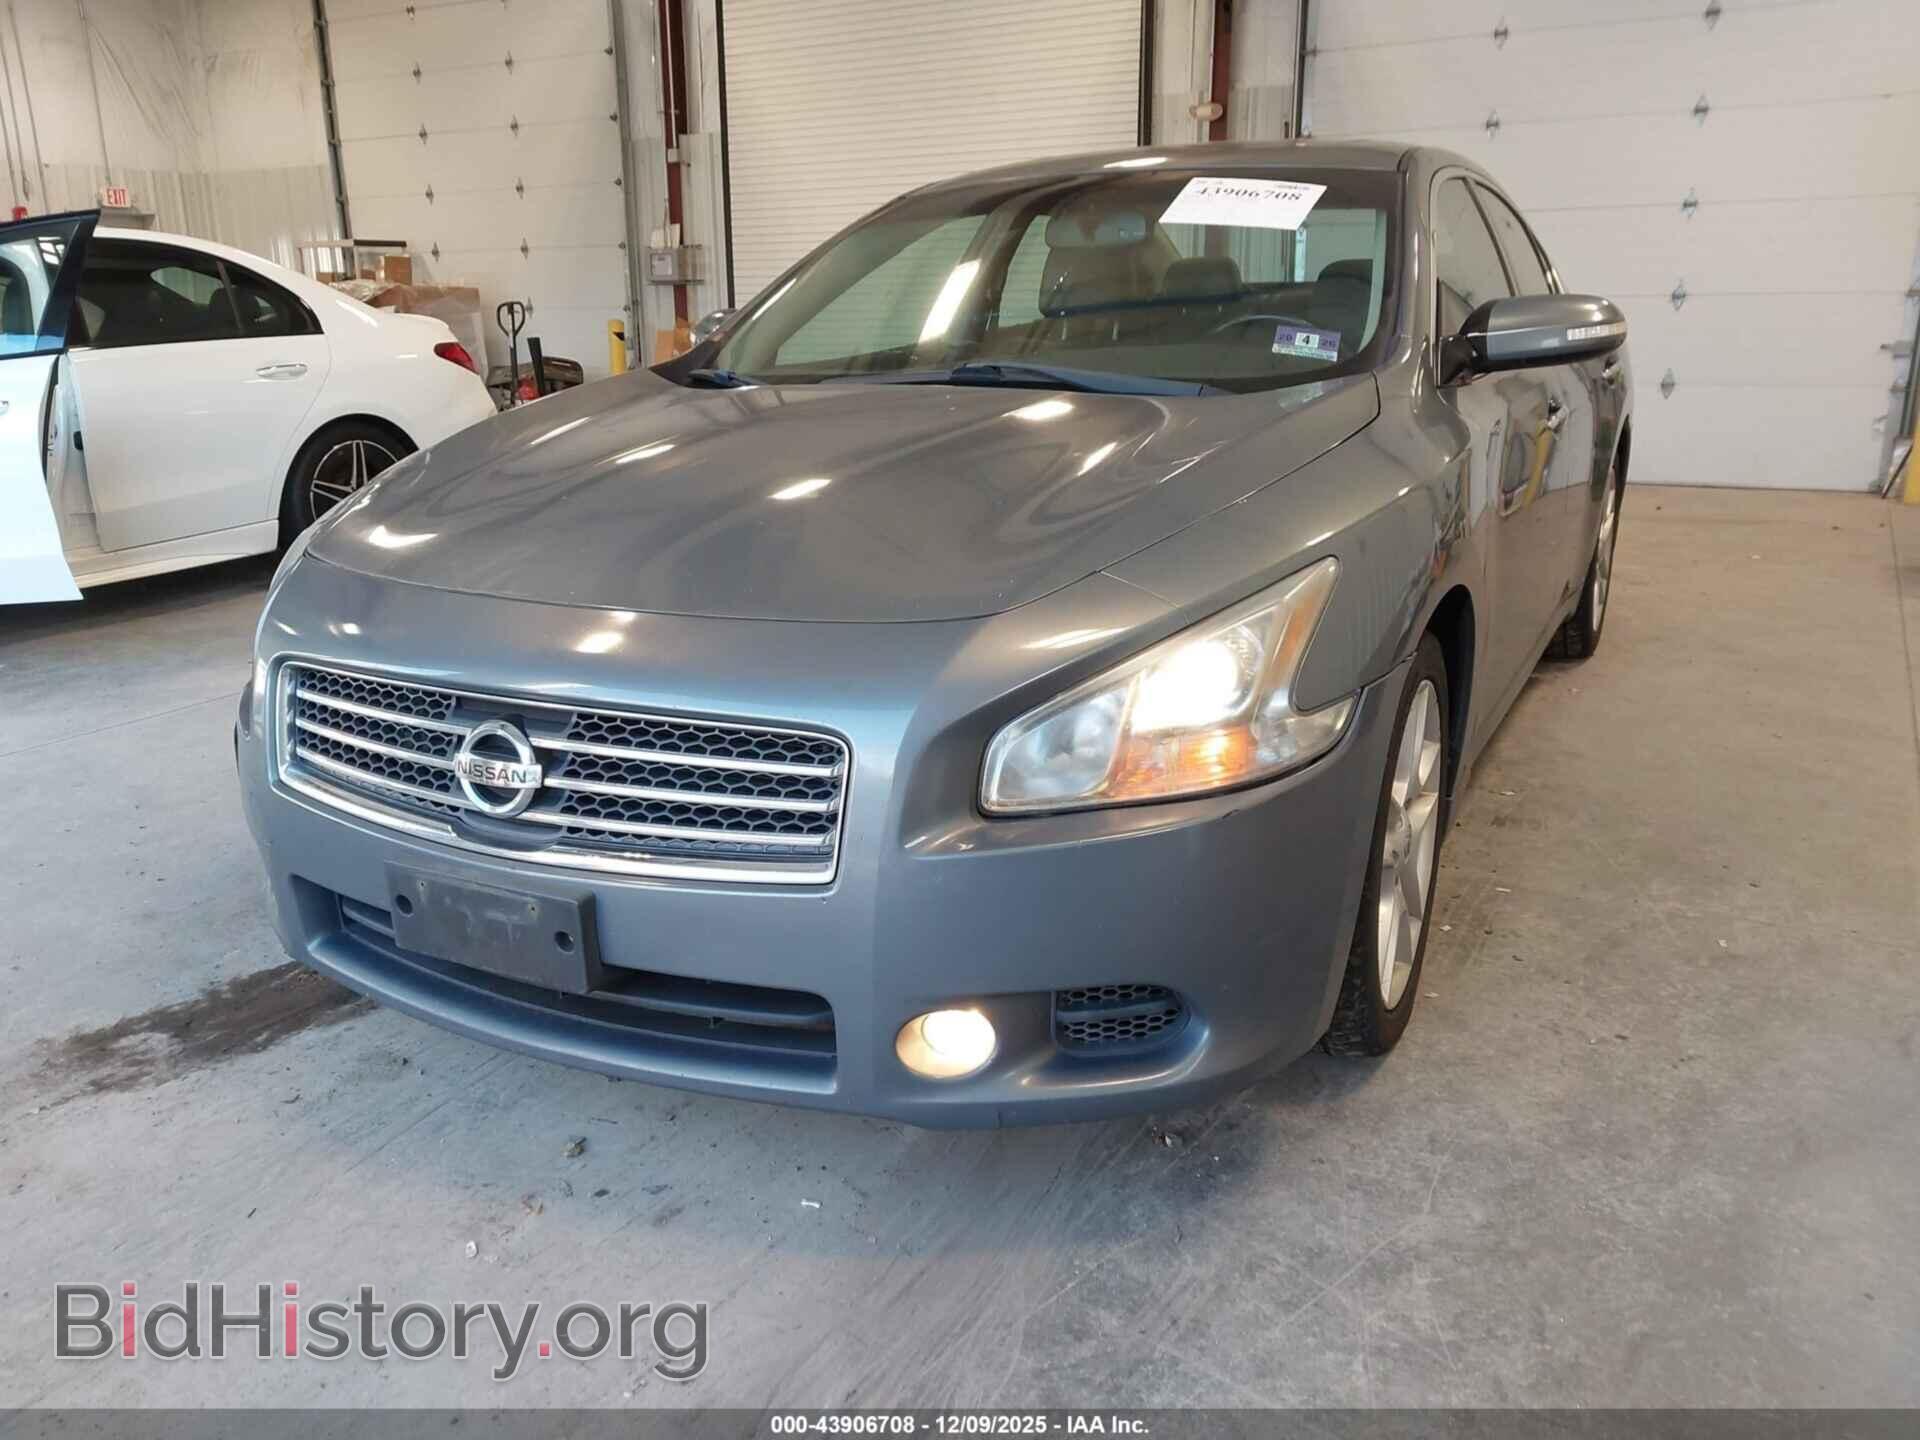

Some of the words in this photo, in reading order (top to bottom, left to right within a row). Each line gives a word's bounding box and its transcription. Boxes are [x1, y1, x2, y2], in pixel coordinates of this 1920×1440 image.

[106, 189, 127, 205] EXIT
[1302, 335, 1311, 345] 4
[457, 760, 527, 784] NISSAN
